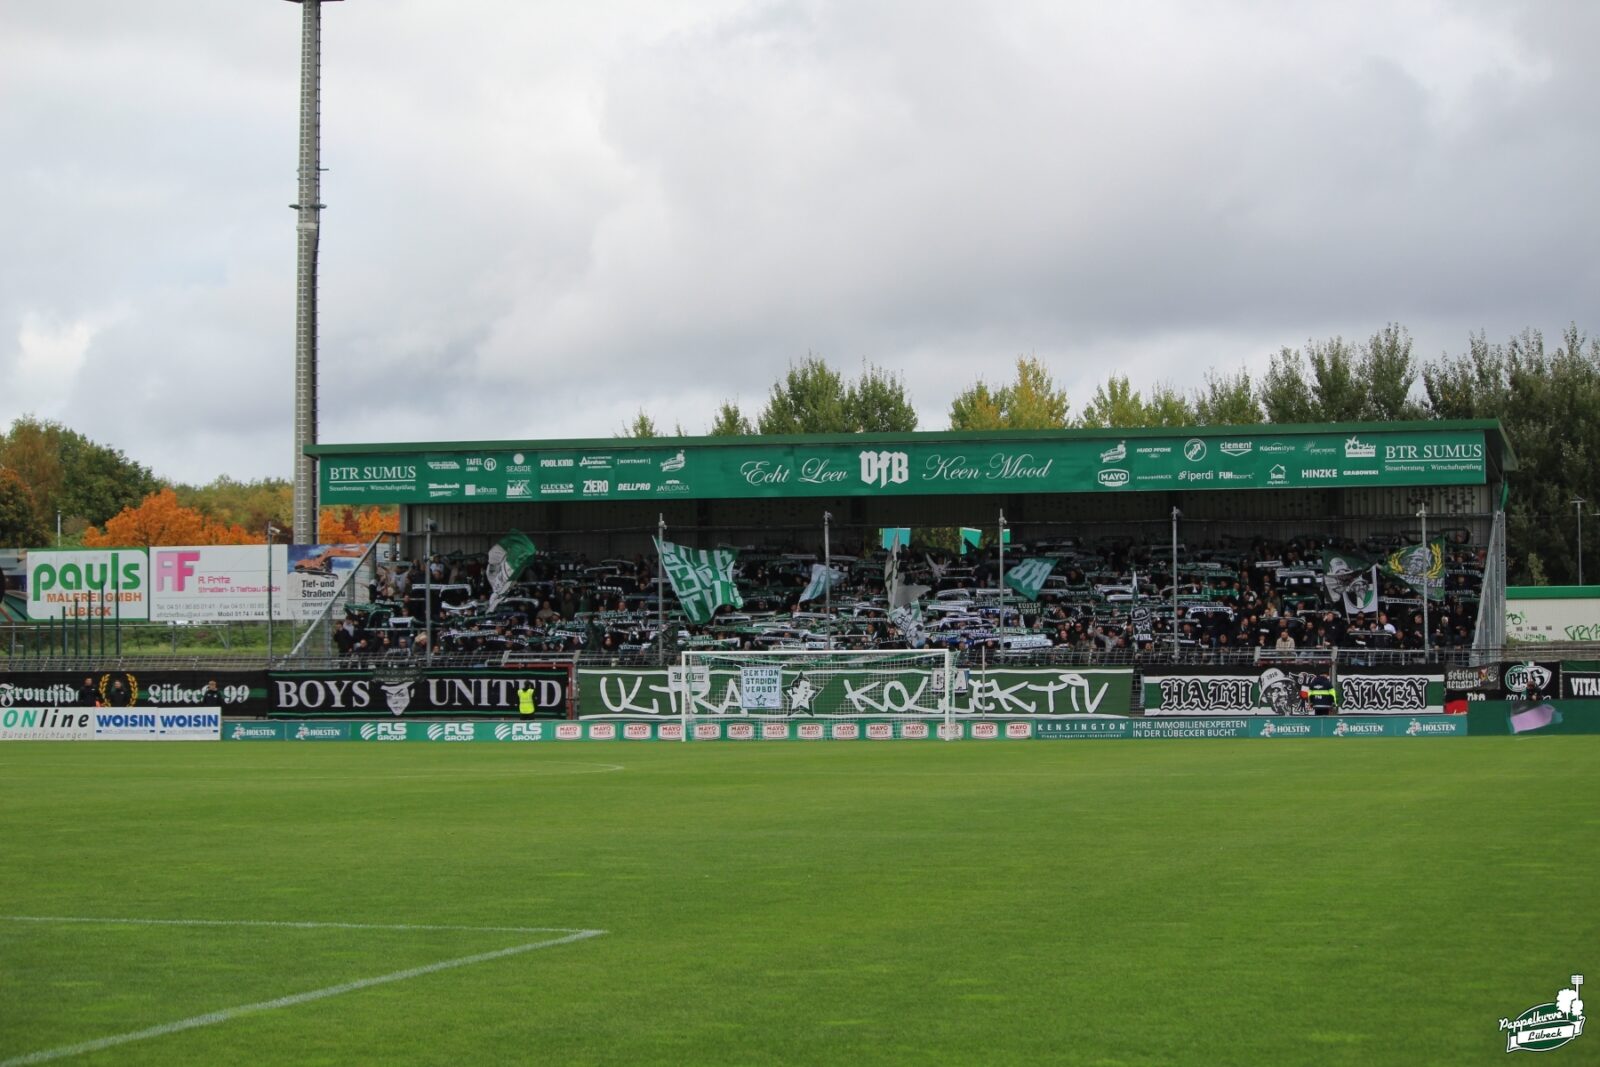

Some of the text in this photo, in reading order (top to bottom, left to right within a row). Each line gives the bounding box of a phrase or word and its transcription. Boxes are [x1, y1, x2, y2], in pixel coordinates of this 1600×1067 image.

[1385, 445, 1418, 458] BTR
[1424, 444, 1482, 458] SUMUS
[466, 458, 482, 466] TAFEL
[922, 453, 1053, 480] Keen Mood
[330, 466, 416, 480] BTR SUMUS
[506, 465, 531, 473] SEASIDE
[740, 459, 790, 486] Echt
[1302, 469, 1337, 478] HINZKE
[1188, 470, 1213, 482] iperdi
[618, 483, 651, 491] DELLPRO
[33, 553, 141, 601] pauls
[208, 576, 231, 584] Fritz
[302, 580, 319, 588] Tief-
[745, 677, 777, 685] STADION
[275, 680, 370, 708] BOYS
[745, 685, 777, 693] VERBOT
[223, 685, 250, 704] 99
[96, 715, 156, 728] WOISIN
[160, 715, 218, 727] WOISIN
[1133, 720, 1247, 729] IHRE IMMOBILIENEXPERTEN
[377, 723, 407, 735] FLS
[445, 723, 474, 735] FLS
[512, 723, 542, 735] FLS
[1163, 728, 1205, 737] LÜBECKER
[1207, 729, 1237, 737] BUCHT.
[1277, 725, 1310, 733] HOLSTEN
[1350, 725, 1383, 733] HOLSTEN
[1423, 724, 1456, 732] HOLSTEN
